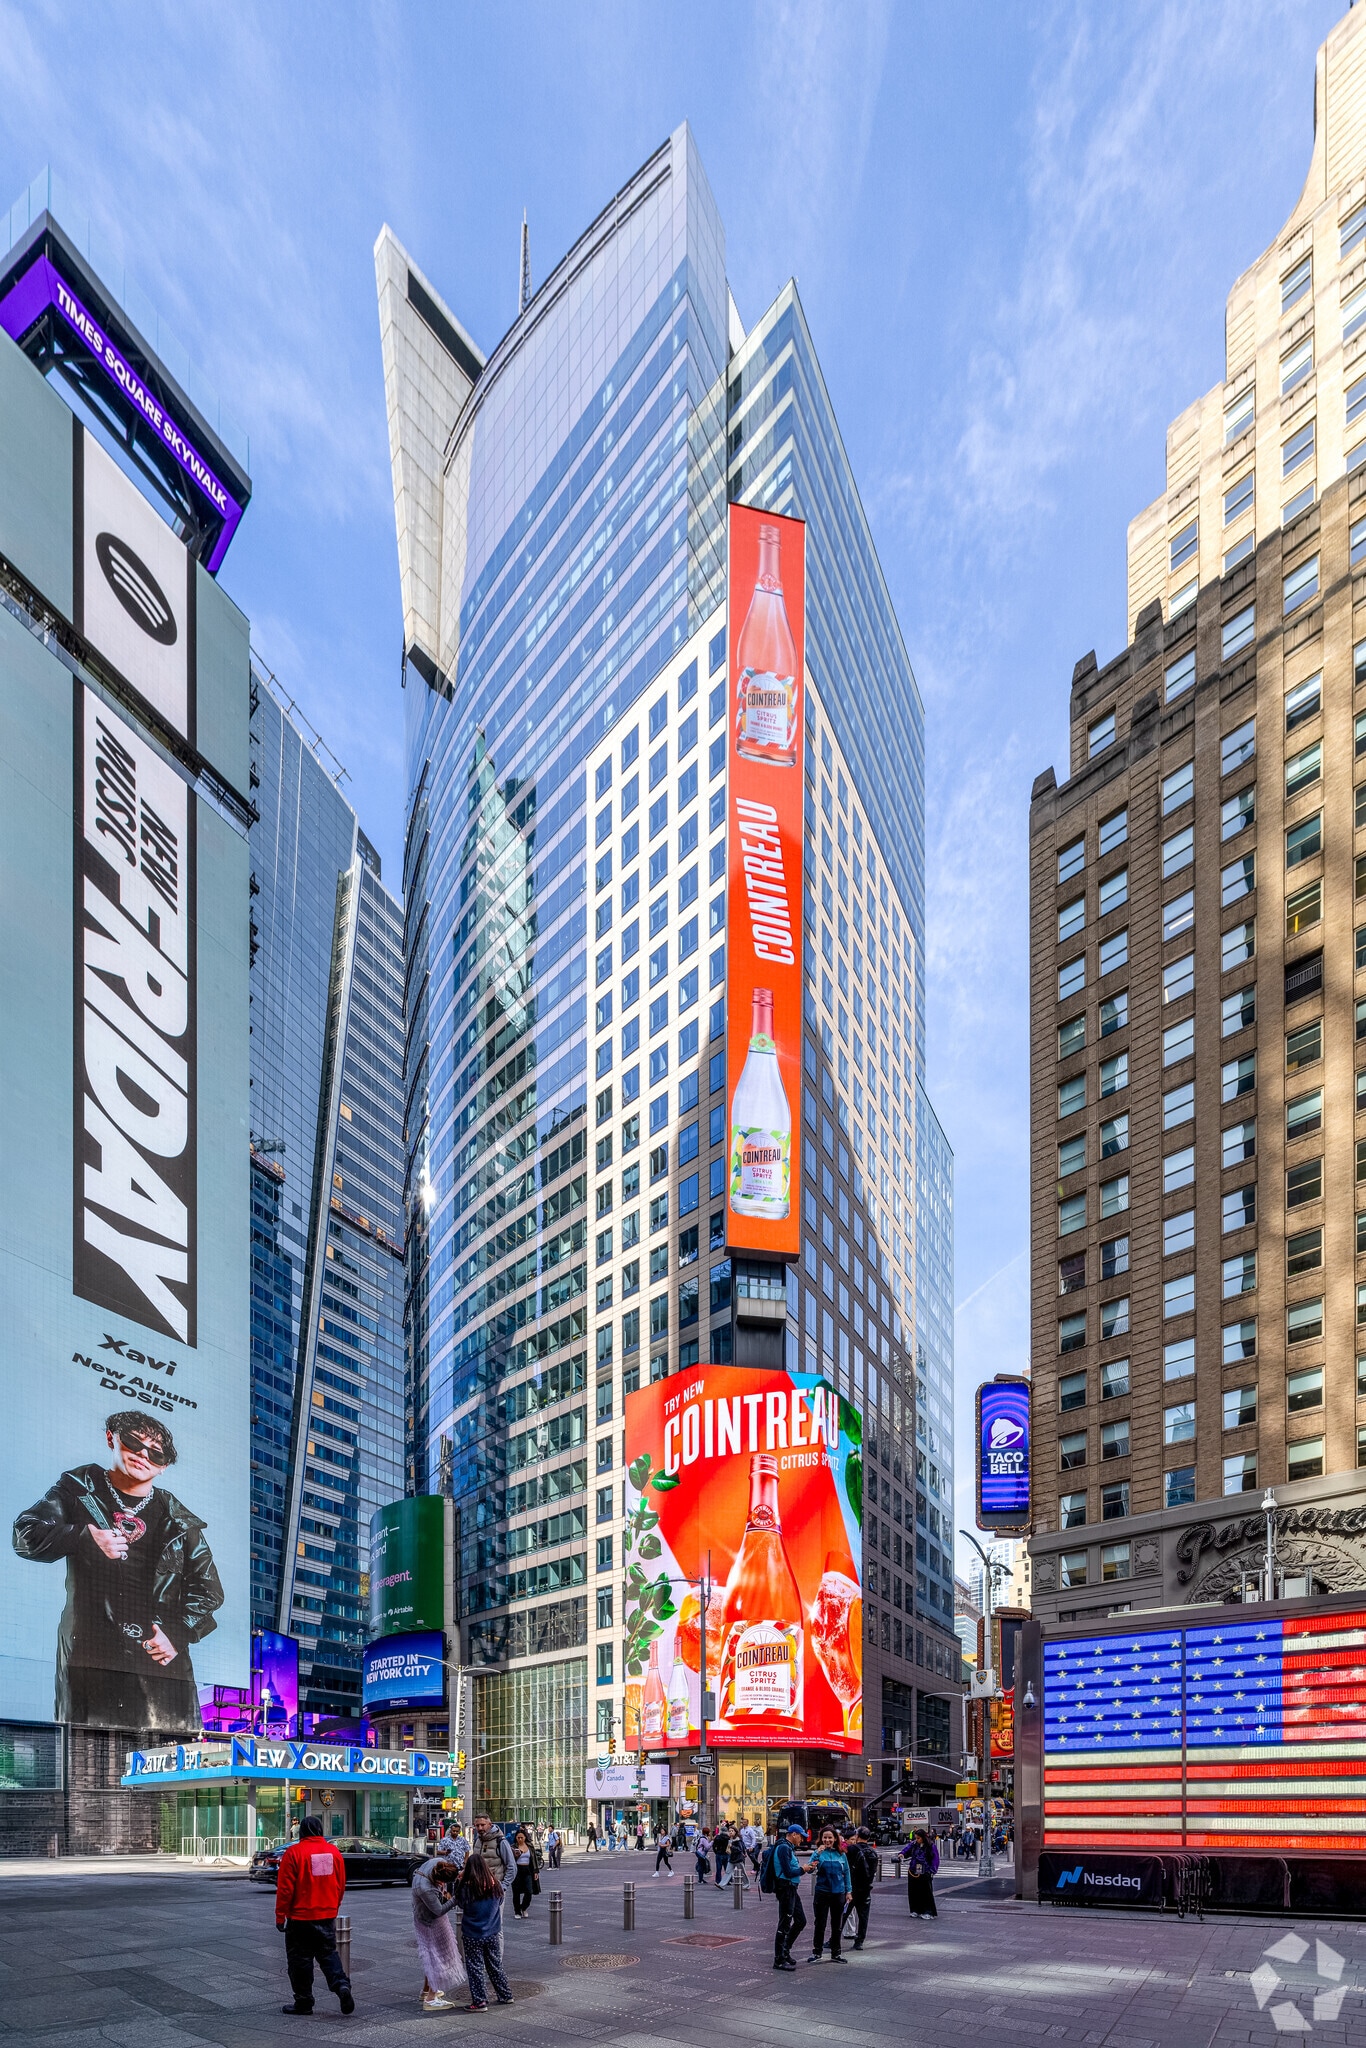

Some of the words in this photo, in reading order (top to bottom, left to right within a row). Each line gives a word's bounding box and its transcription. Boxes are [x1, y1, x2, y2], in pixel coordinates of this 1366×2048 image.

[57, 283, 103, 353] TIMES
[104, 347, 162, 428] SQUARE
[163, 421, 227, 511] SKYWALK
[747, 692, 787, 706] COINTREAU
[95, 715, 137, 868] MUSIC
[140, 796, 178, 916] NEW
[735, 797, 795, 966] COINTREAU
[742, 1148, 781, 1164] COINTREAU
[97, 1332, 178, 1376] Xavi
[72, 1352, 126, 1380] New
[127, 1376, 198, 1409] Album
[99, 1377, 174, 1412] DOSIS
[664, 1391, 681, 1416] TRY
[683, 1380, 705, 1404] NEW
[664, 1386, 841, 1477] COINTREAU
[780, 1452, 819, 1470] CITRUS
[821, 1454, 840, 1471] SPRITZ
[988, 1452, 1024, 1464] TACO
[990, 1463, 1024, 1475] BELL
[1176, 1503, 1366, 1583] Paramou
[393, 1605, 414, 1616] Airtable
[370, 1655, 406, 1672] STARTED
[406, 1654, 419, 1666] IN
[737, 1645, 789, 1669] COINTREAU
[366, 1671, 379, 1685] NEW
[380, 1667, 403, 1681] YORK
[403, 1665, 431, 1678] CITY
[749, 1670, 778, 1678] CITRUS
[750, 1677, 776, 1685] SPRITZ
[231, 1737, 286, 1768] NEW
[287, 1742, 344, 1772] YORK
[345, 1748, 407, 1775] POLICE
[612, 1753, 636, 1766] AT&T
[606, 1774, 625, 1782] Canada
[829, 1781, 855, 1794] TOURO
[412, 1795, 442, 1805] HASE
[1083, 1872, 1142, 1891] Nasdaq
